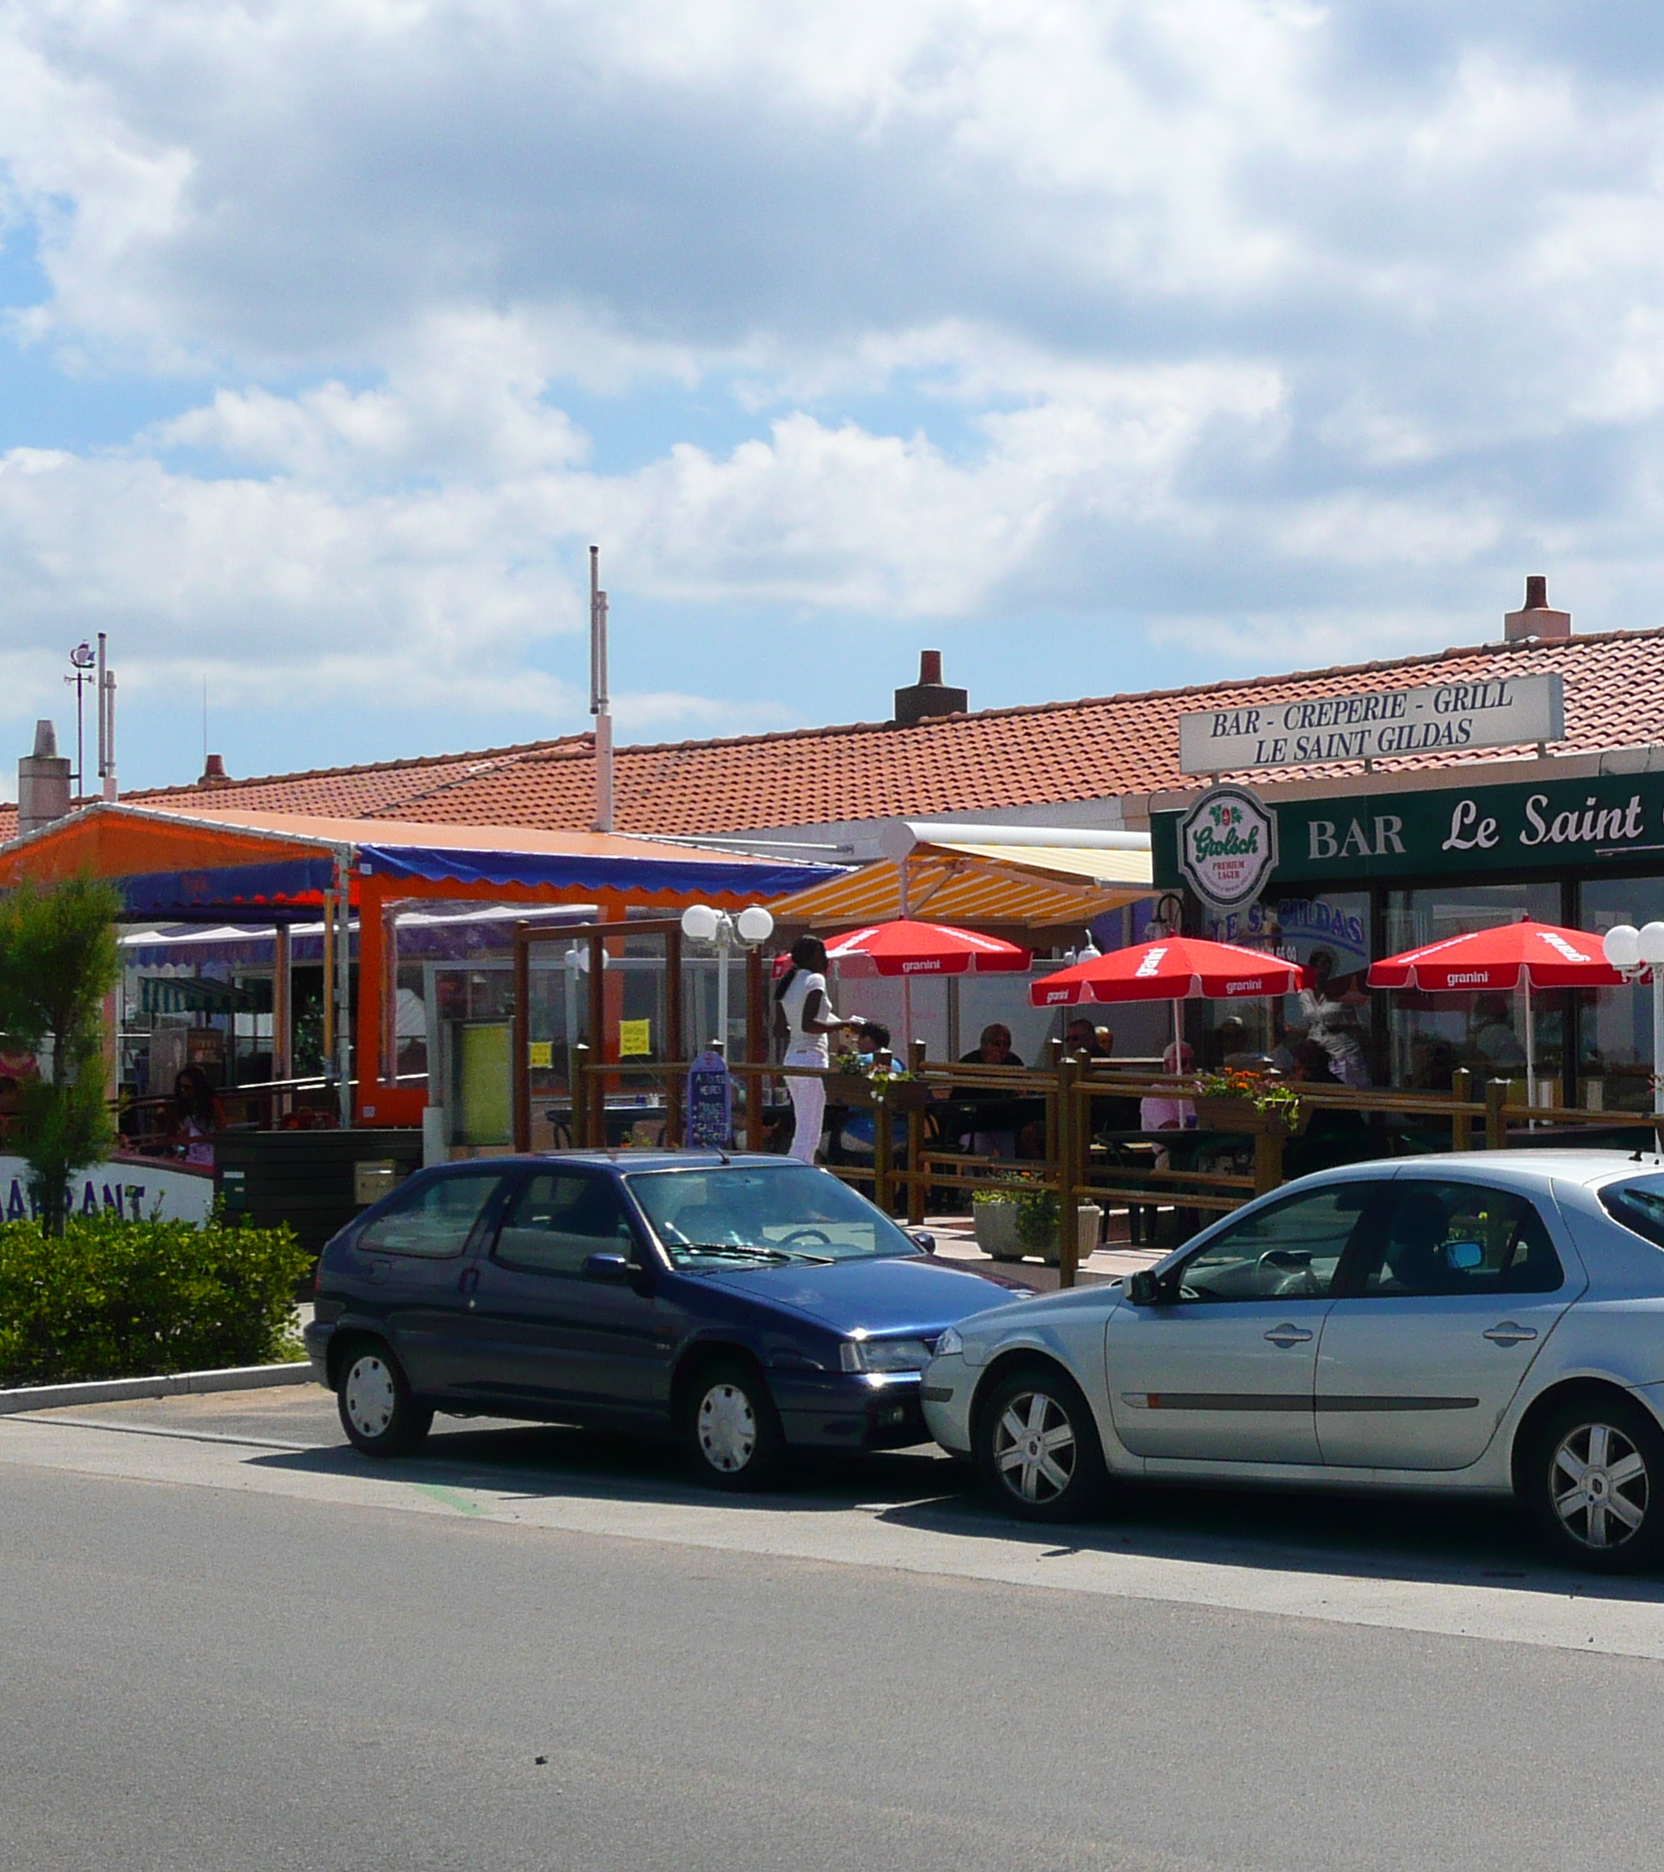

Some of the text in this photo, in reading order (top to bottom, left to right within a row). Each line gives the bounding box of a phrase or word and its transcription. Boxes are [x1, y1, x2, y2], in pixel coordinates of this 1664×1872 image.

[1210, 709, 1261, 738] BAR
[1283, 692, 1408, 731] CREPERIE
[1433, 681, 1514, 715] GRILL
[1253, 717, 1473, 765] LE SAINT GILDAS
[1441, 799, 1500, 851] Le
[1519, 793, 1644, 846] Saint
[1192, 825, 1260, 864] Grolsch
[1307, 814, 1407, 860] BAR
[1212, 860, 1246, 871] PREMIUM
[1218, 870, 1240, 880] LAGER
[1276, 898, 1365, 945] GILDAS
[902, 959, 941, 973] granini
[1446, 971, 1489, 986] granini
[1046, 989, 1069, 1003] granini
[1226, 978, 1263, 994] granini
